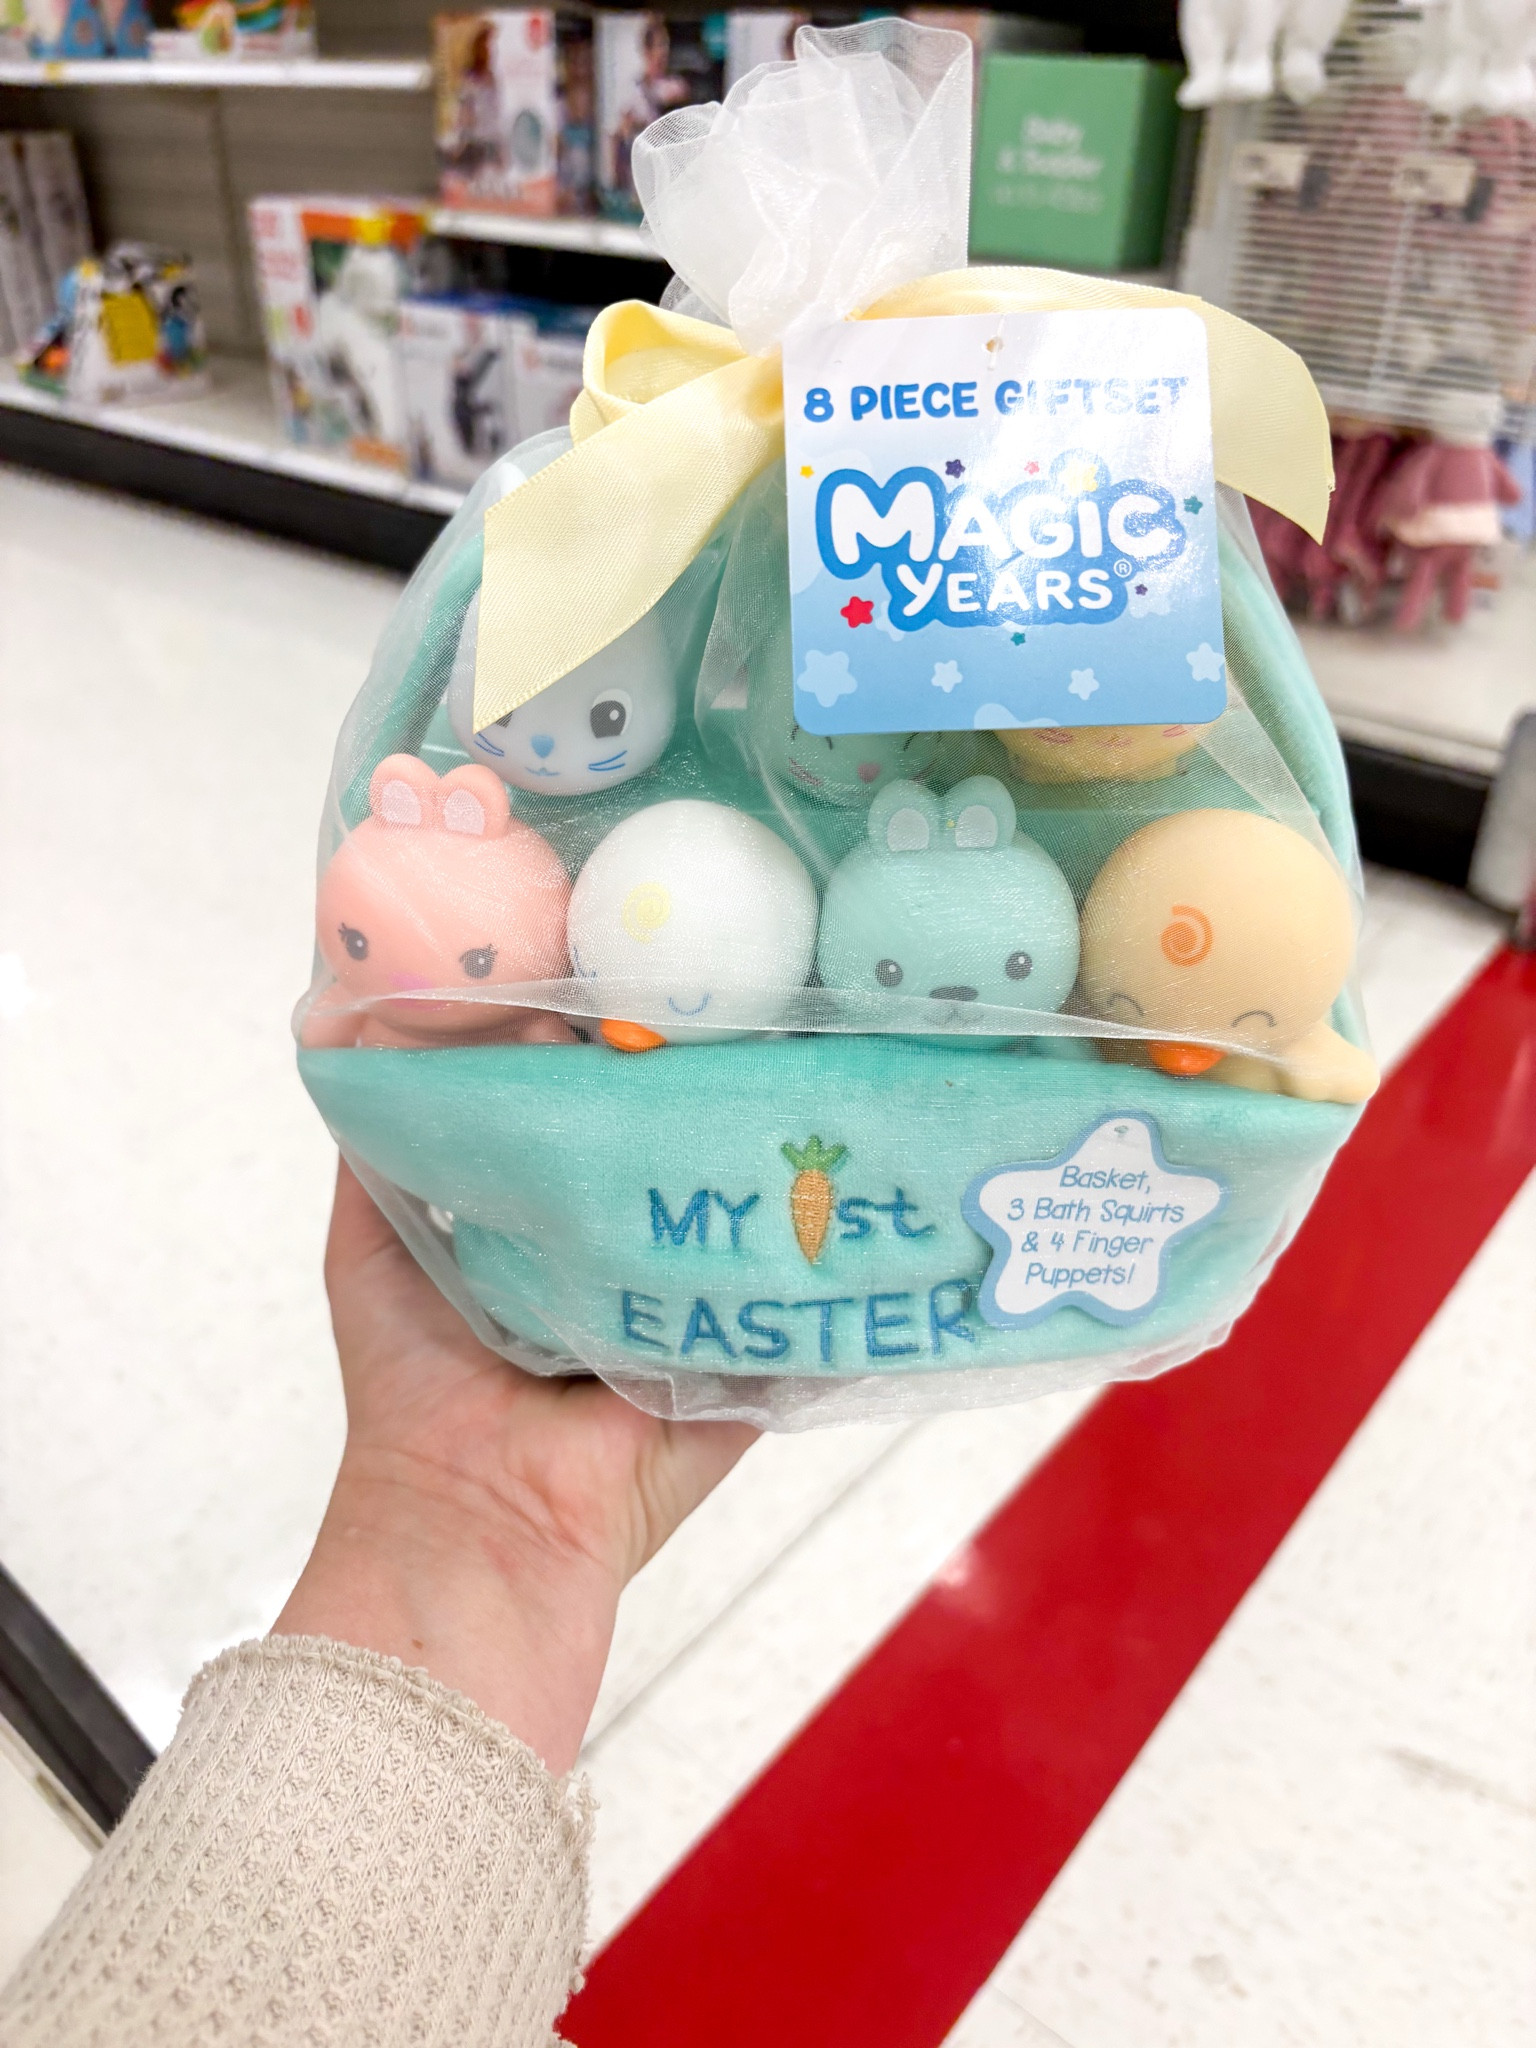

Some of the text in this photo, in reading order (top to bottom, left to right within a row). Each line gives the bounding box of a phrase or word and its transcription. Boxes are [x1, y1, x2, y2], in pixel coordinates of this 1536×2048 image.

[803, 376, 1189, 422] 8 PIECE GIFTSET
[830, 480, 1177, 565] MAGIC
[1059, 1165, 1152, 1194] Basket,
[648, 1186, 761, 1248] MY
[1007, 1196, 1185, 1226] 3 Bath Squirts
[1021, 1230, 1153, 1258] & 4 Finger
[1025, 1262, 1136, 1288] Puppets!
[621, 1277, 976, 1363] EASTER
